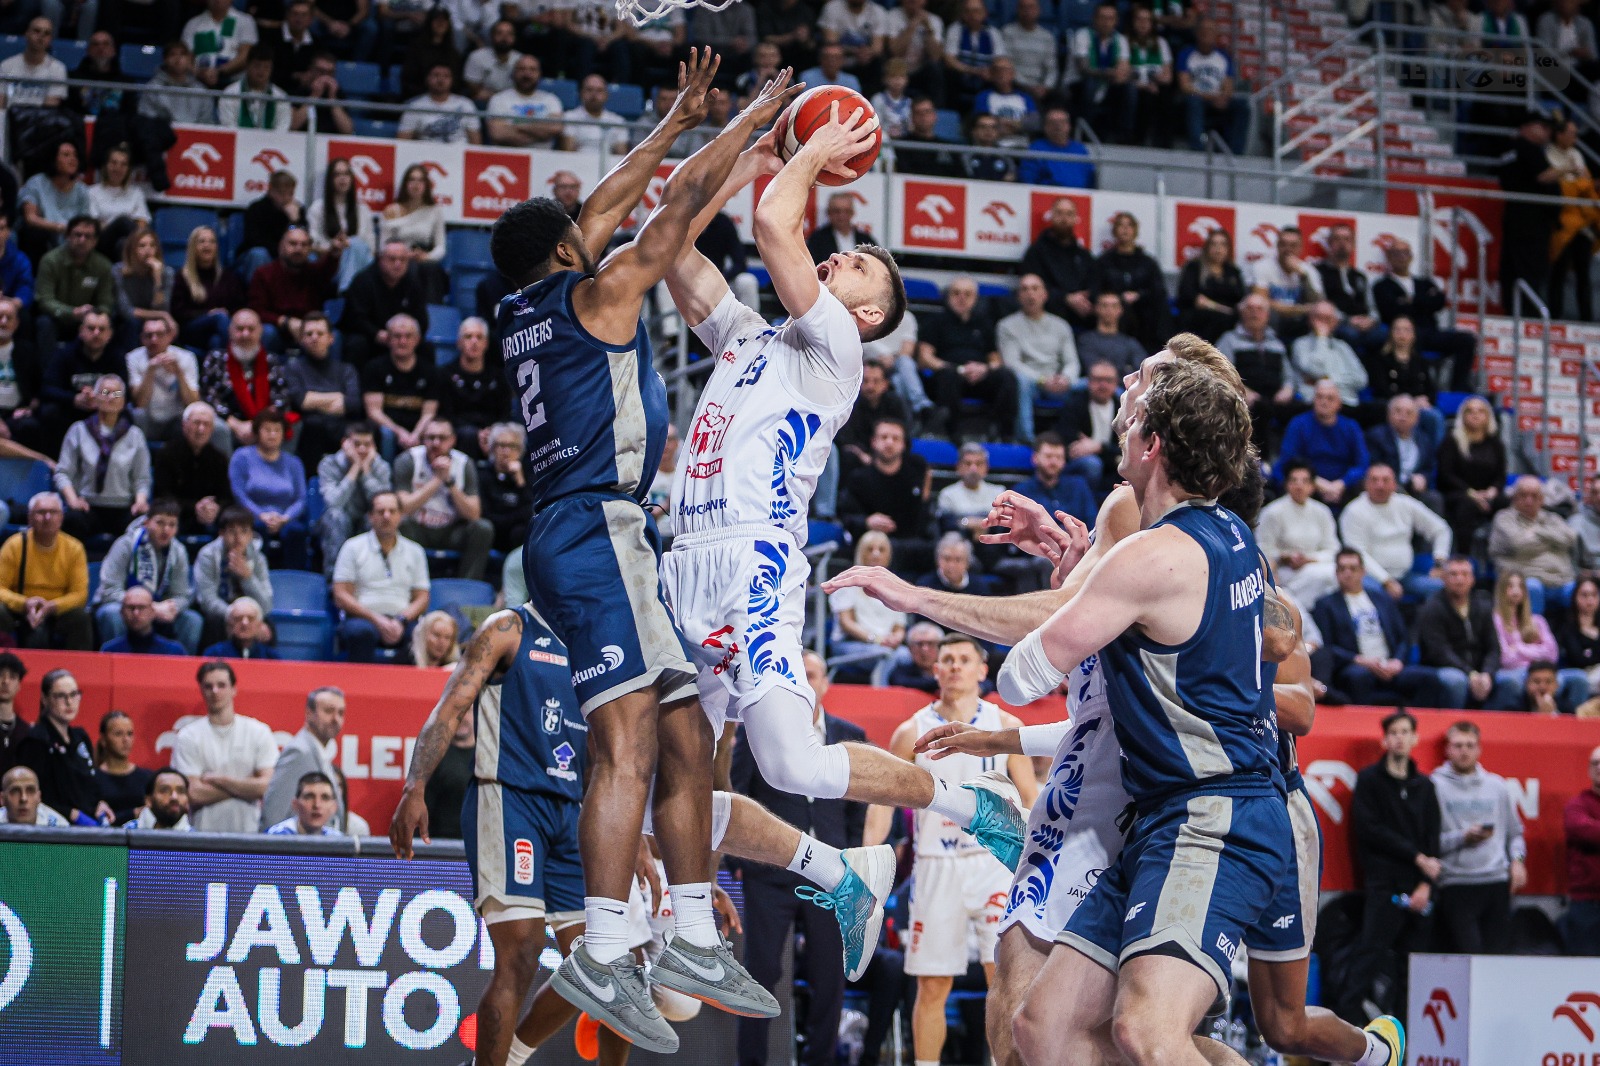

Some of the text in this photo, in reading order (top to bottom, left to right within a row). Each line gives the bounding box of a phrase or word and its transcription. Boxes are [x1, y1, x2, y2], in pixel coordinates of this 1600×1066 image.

[516, 359, 547, 432] 2
[548, 446, 579, 465] SERVICES
[1272, 914, 1296, 929] 4F
